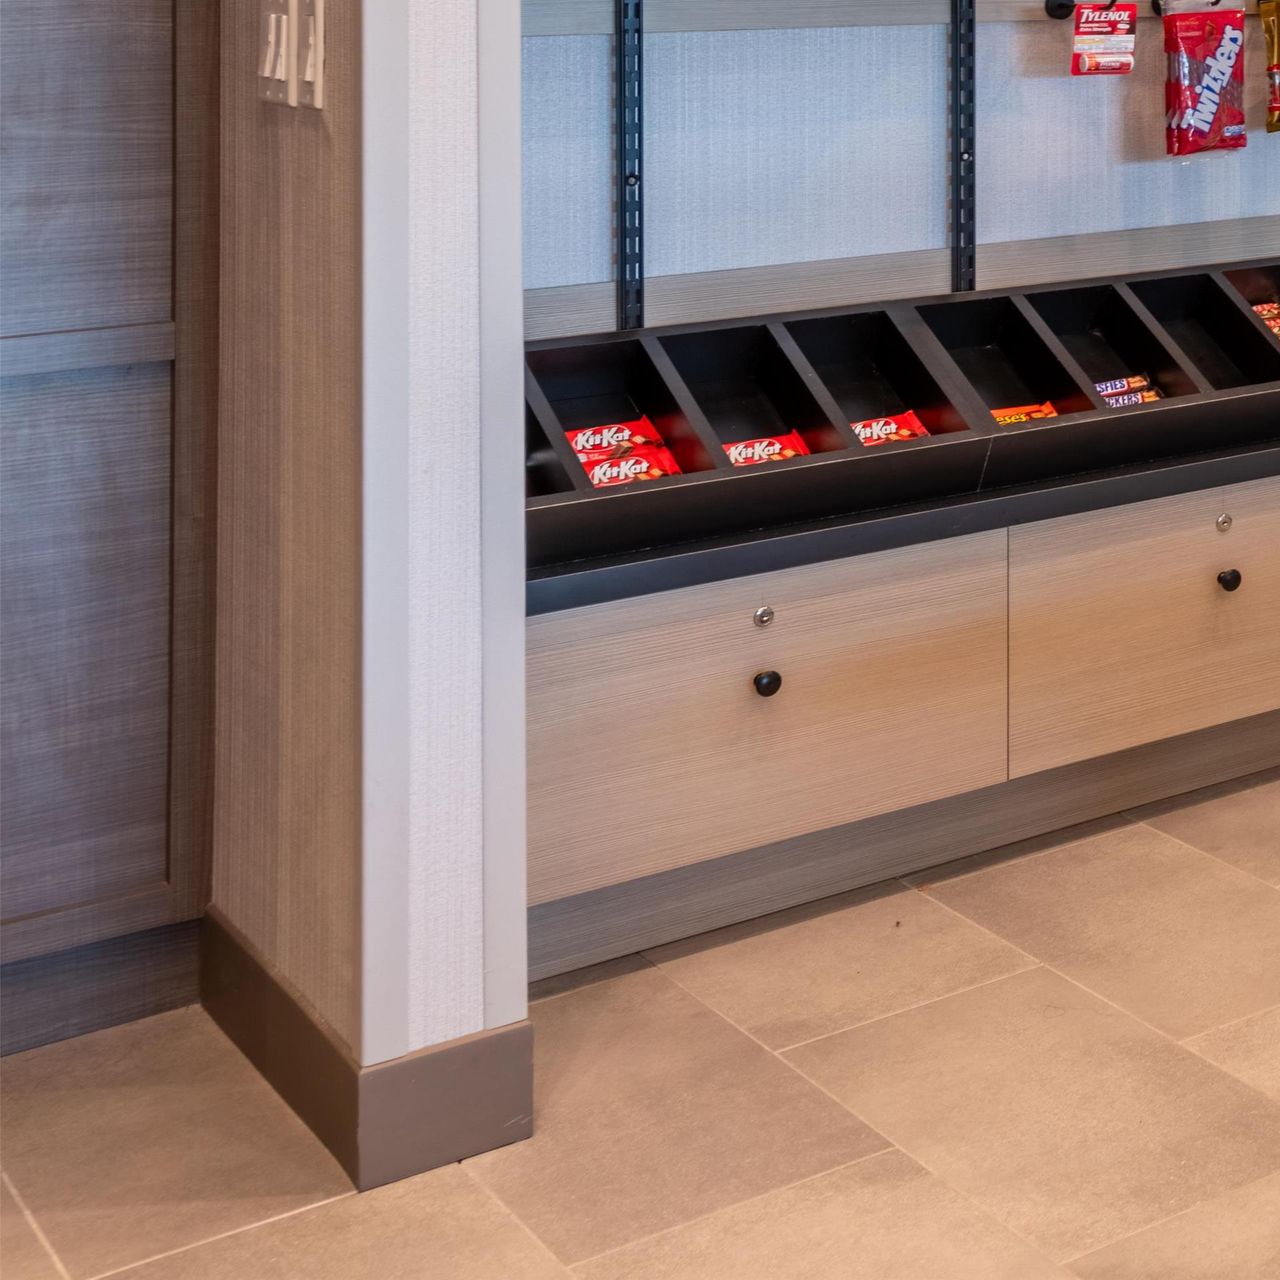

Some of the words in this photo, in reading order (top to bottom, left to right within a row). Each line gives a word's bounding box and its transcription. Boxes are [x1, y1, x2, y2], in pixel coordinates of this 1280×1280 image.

[1080, 9, 1131, 22] TYLENOL
[1181, 24, 1245, 133] Twizzlers
[1109, 393, 1140, 408] CKERS
[576, 425, 632, 451] KitKat
[728, 438, 783, 464] KitKat
[592, 458, 650, 484] KitKat
